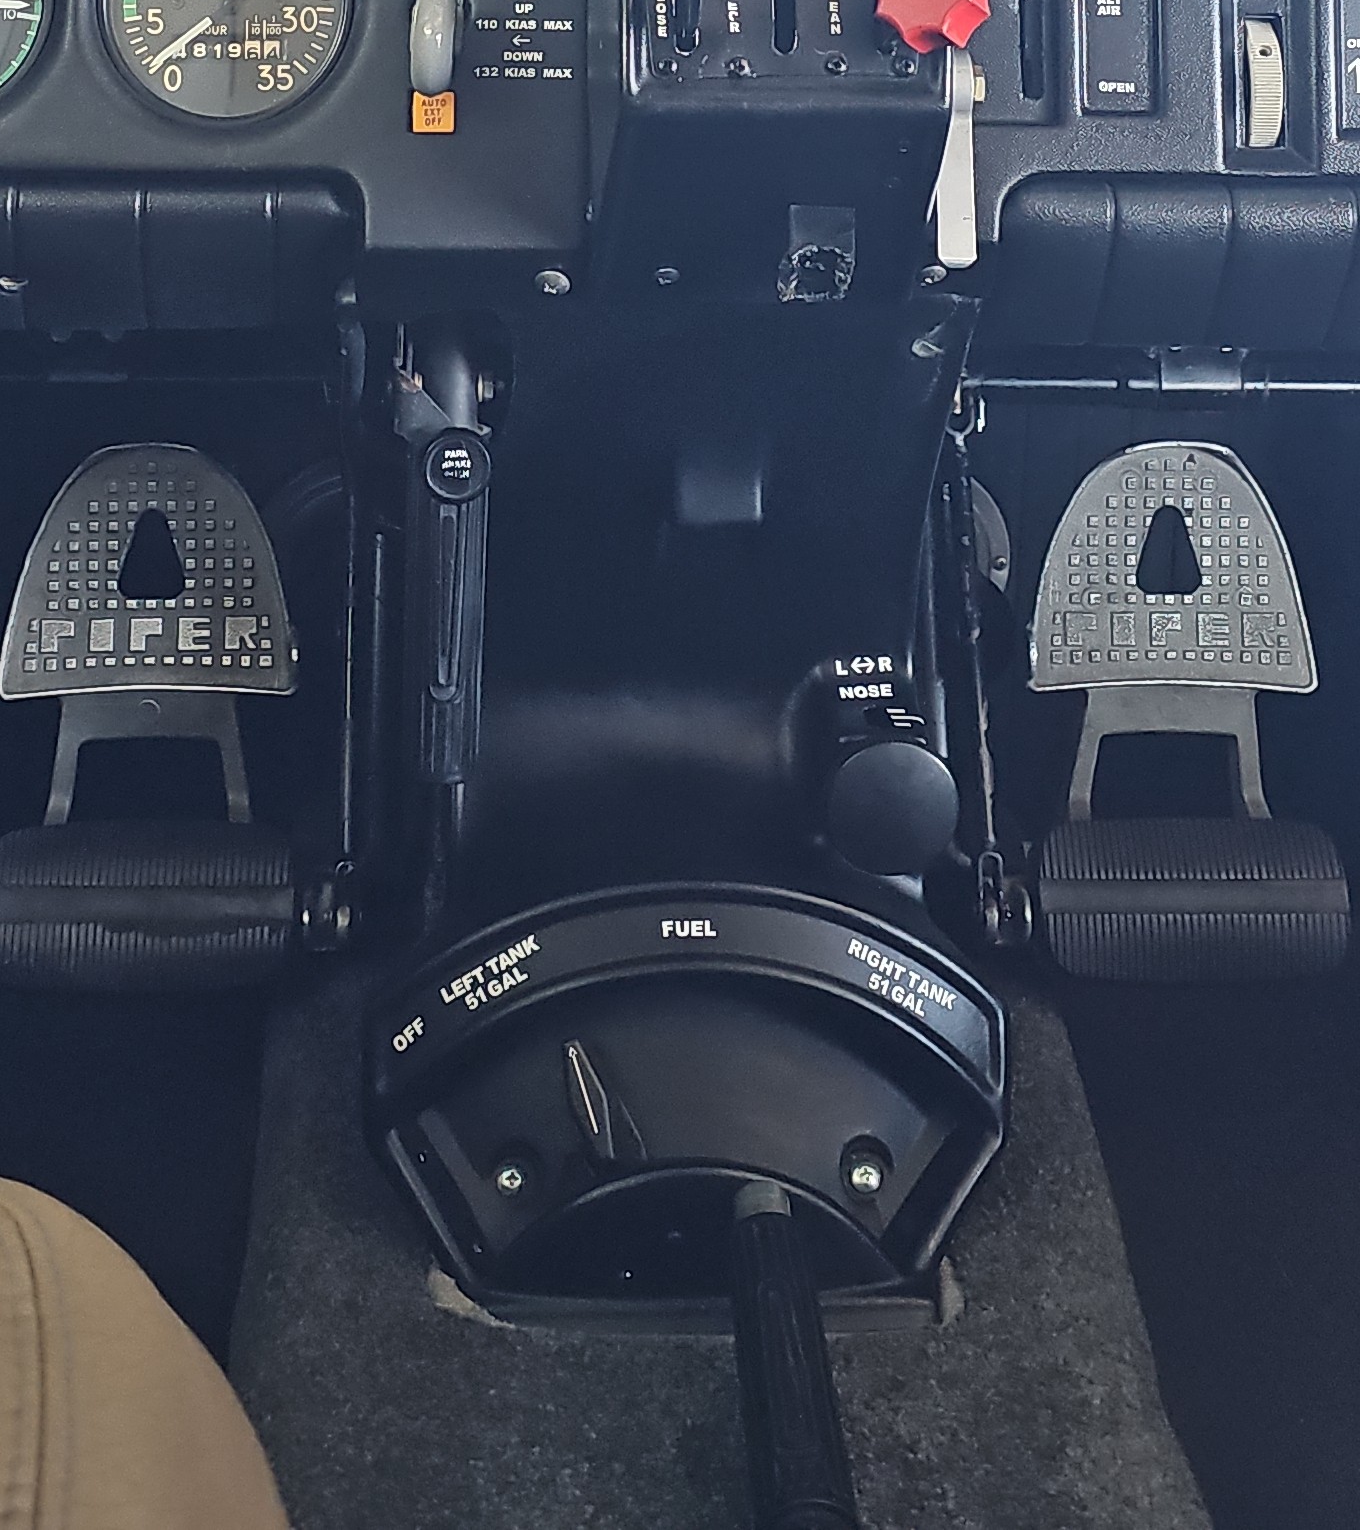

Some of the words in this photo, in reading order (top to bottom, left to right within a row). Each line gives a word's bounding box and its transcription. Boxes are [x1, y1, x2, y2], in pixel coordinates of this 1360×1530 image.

[516, 4, 533, 13] UP
[1097, 5, 1120, 16] AIR
[282, 7, 317, 32] 30
[476, 20, 497, 29] 110
[506, 20, 536, 29] KIAS
[544, 20, 572, 30] MAX
[504, 52, 543, 61] DOWN
[258, 65, 293, 90] 35
[474, 68, 498, 77] 132
[505, 68, 536, 78] KIAS
[543, 69, 572, 78] MAX
[1099, 82, 1134, 92] OPEN
[422, 98, 446, 106] AUTO
[41, 617, 256, 653] PIPER
[1064, 612, 1276, 647] PIPER
[839, 683, 893, 699] NOSE
[662, 920, 716, 938] FUEL
[439, 967, 486, 1005] LEFT
[484, 934, 541, 977] TANK
[847, 939, 906, 979] RIGHT
[907, 972, 957, 1011] TANK
[464, 989, 488, 1011] 51
[487, 967, 529, 998] GAL
[867, 973, 891, 996] 51
[889, 986, 926, 1017] GAL
[392, 1017, 427, 1054] OFF
